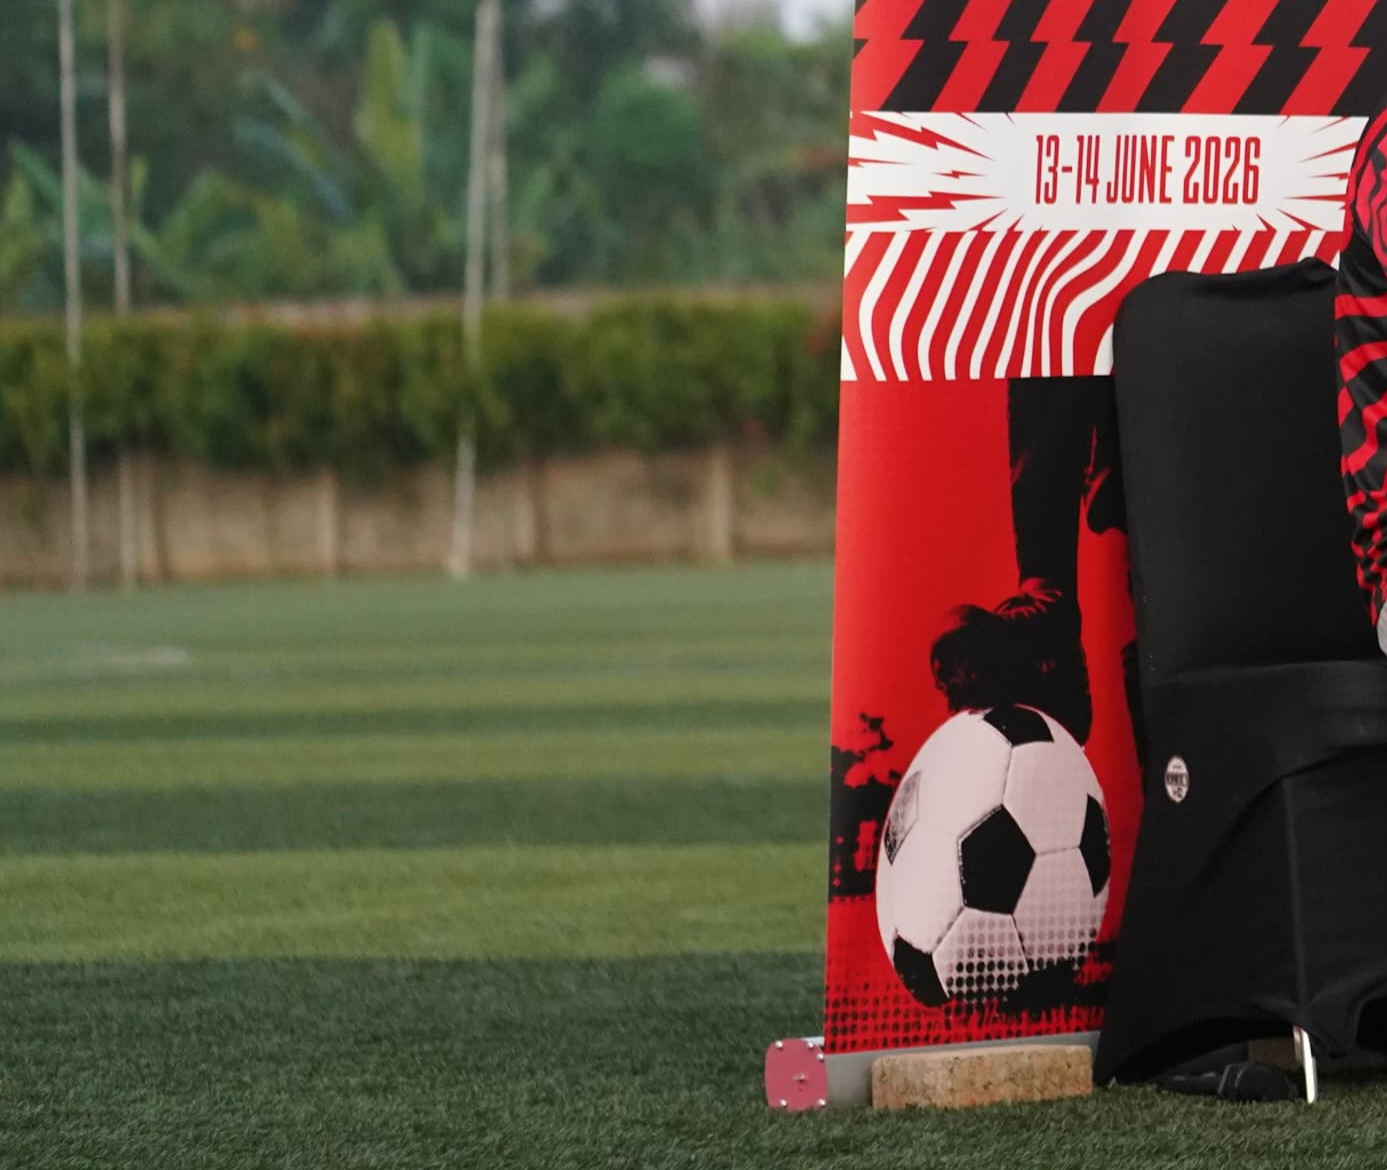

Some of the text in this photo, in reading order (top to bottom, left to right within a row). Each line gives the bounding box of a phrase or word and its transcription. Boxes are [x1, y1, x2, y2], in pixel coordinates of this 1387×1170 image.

[1035, 134, 1261, 205] 13-14 JUNE 2026
